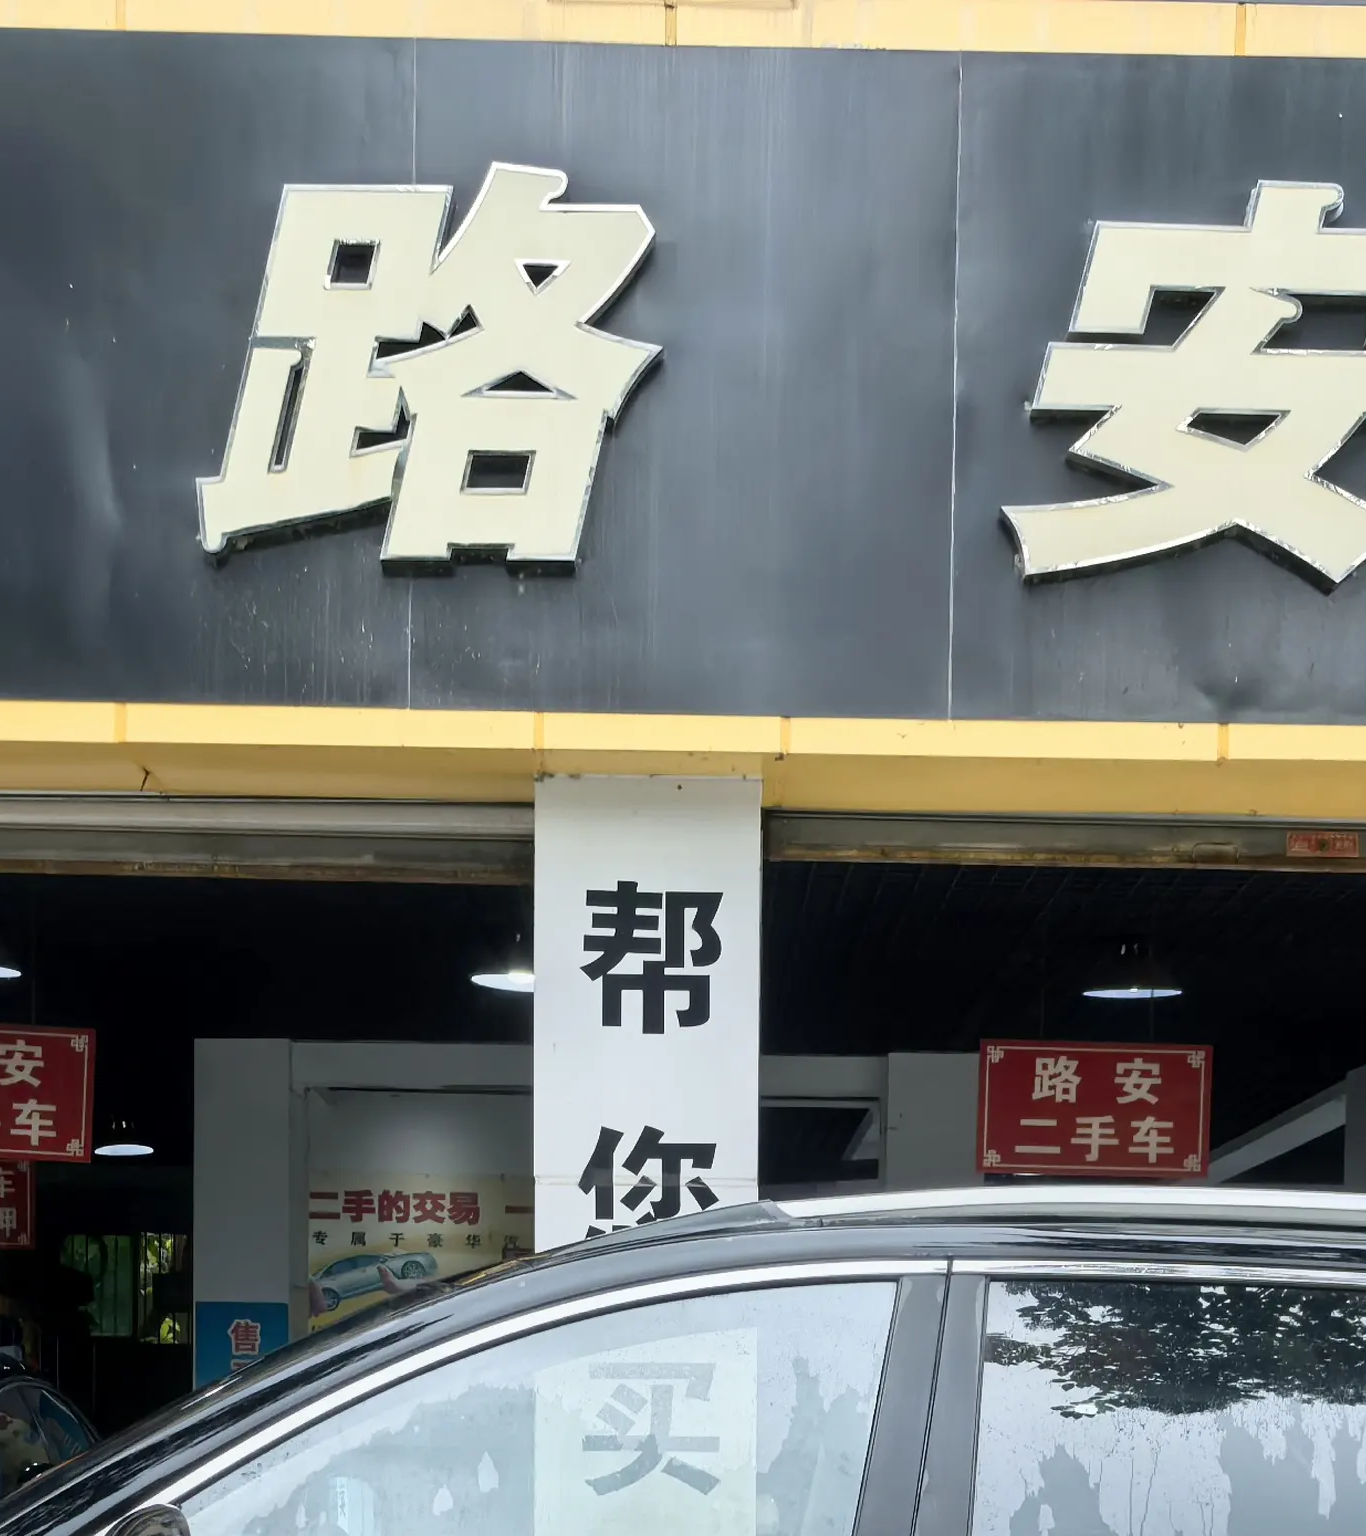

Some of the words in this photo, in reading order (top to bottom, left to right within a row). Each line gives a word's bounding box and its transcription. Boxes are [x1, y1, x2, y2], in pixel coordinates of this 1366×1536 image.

[1032, 1055, 1163, 1106] 路安
[1013, 1115, 1176, 1164] 二手车
[308, 1189, 482, 1227] 二手的交易
